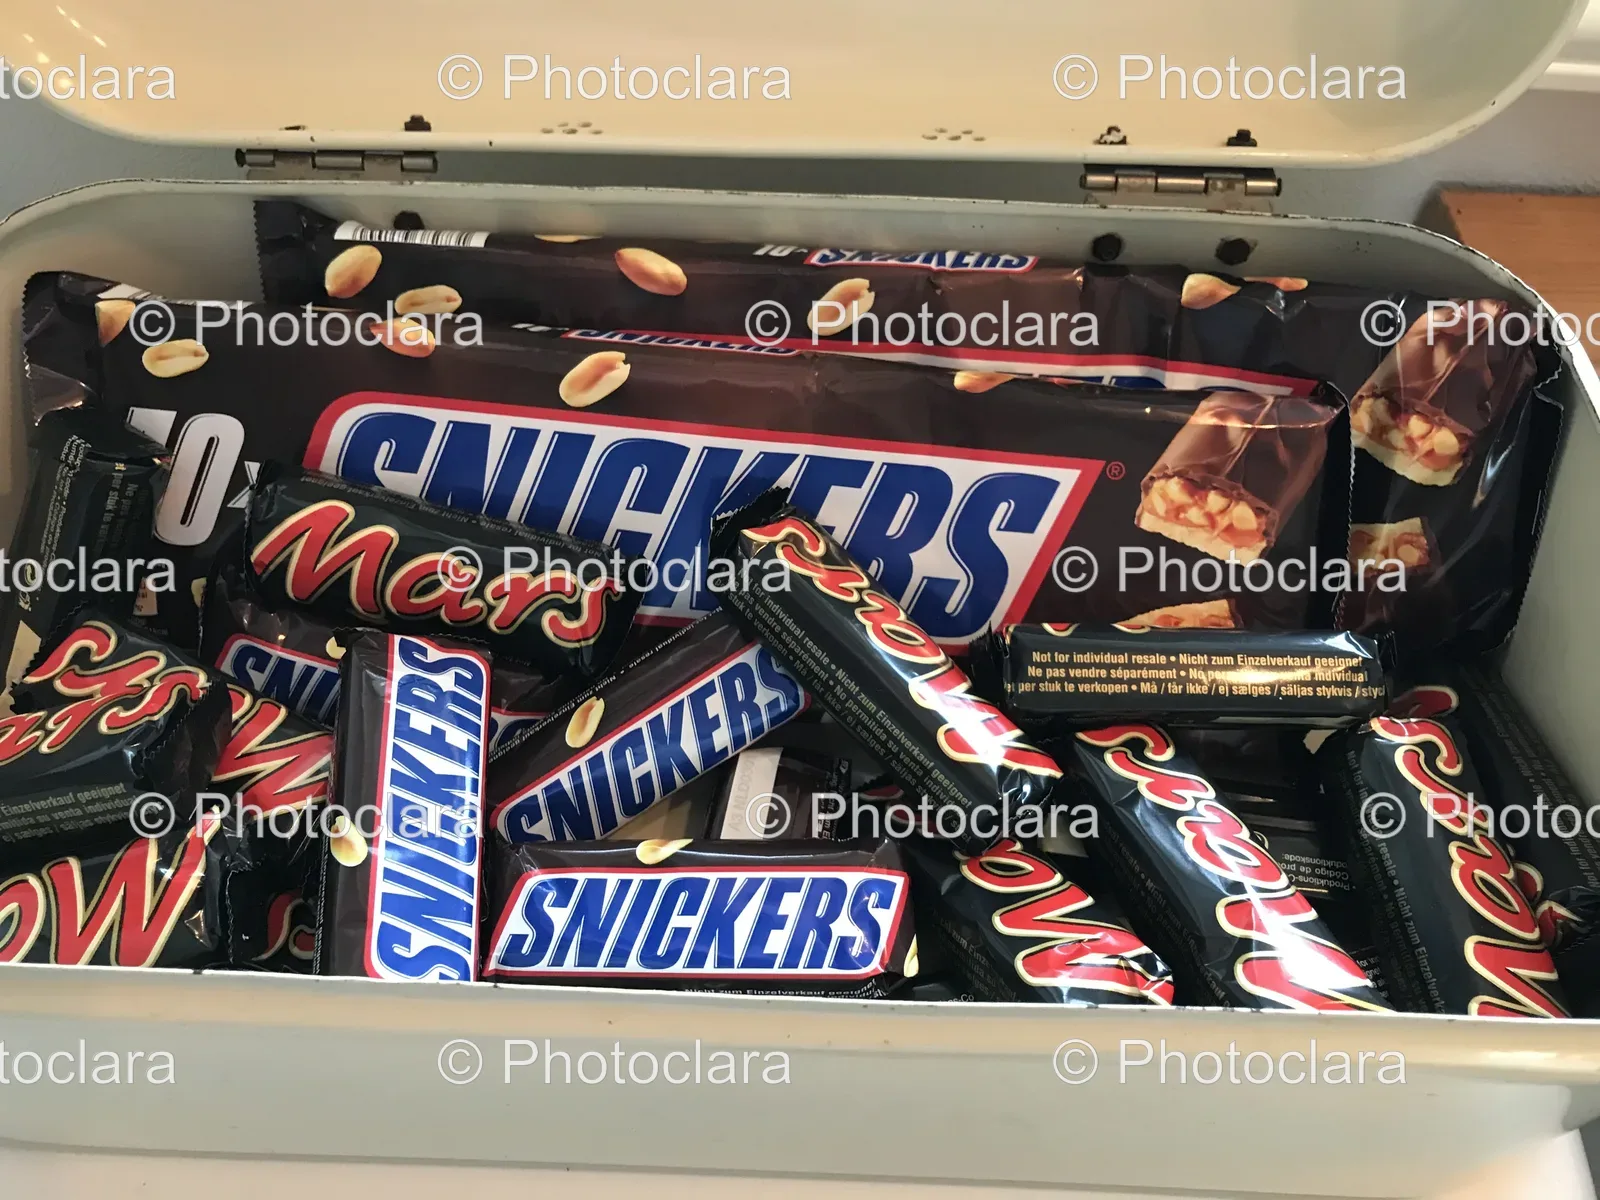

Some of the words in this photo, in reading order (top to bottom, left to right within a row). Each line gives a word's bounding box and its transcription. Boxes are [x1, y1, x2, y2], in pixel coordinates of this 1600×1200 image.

[250, 499, 624, 648] Mars
[762, 595, 805, 639] individual
[801, 635, 831, 665] resale
[833, 668, 860, 695] Nicht
[856, 692, 877, 713] zum
[874, 709, 935, 771] Einzelverkauf
[930, 766, 973, 810] geeignet
[1018, 682, 1036, 694] per
[1039, 681, 1061, 693] stuk
[1064, 681, 1075, 693] te
[1077, 682, 1128, 695] verkopen
[1140, 682, 1158, 694] Må
[1167, 682, 1183, 694] får
[1186, 682, 1209, 694] ikke
[1218, 684, 1229, 697] ej
[1232, 684, 1271, 697] sælges
[1280, 684, 1313, 698] säljas
[1316, 685, 1351, 698] stykvis
[1361, 686, 1385, 699] styc
[1027, 665, 1043, 678] Ne
[1046, 667, 1065, 680] pas
[1069, 666, 1107, 679] vendre
[1110, 666, 1177, 681] séparément
[1032, 651, 1051, 663] Not
[1054, 651, 1070, 664] for
[1073, 652, 1128, 664] individual
[1131, 652, 1166, 665] resale
[1179, 653, 1208, 665] Nicht
[1211, 655, 1234, 666] zum
[1237, 654, 1311, 667] Einzelverkauf
[1314, 655, 1363, 668] geeignet
[503, 647, 804, 841] SNICKERS
[752, 602, 785, 635] vendre
[779, 629, 831, 682] séparément
[833, 684, 848, 700] No
[844, 697, 889, 742] permitida
[922, 775, 967, 821] individl
[76, 781, 126, 803] geeignet
[376, 636, 486, 981] SNICKERS
[1280, 852, 1349, 869] oduktionskode:
[1286, 873, 1350, 890] Produktions-C
[1376, 840, 1399, 878] resale
[1393, 886, 1413, 919] Nicht
[1404, 919, 1421, 945] zum
[498, 876, 894, 970] SNICKERS
